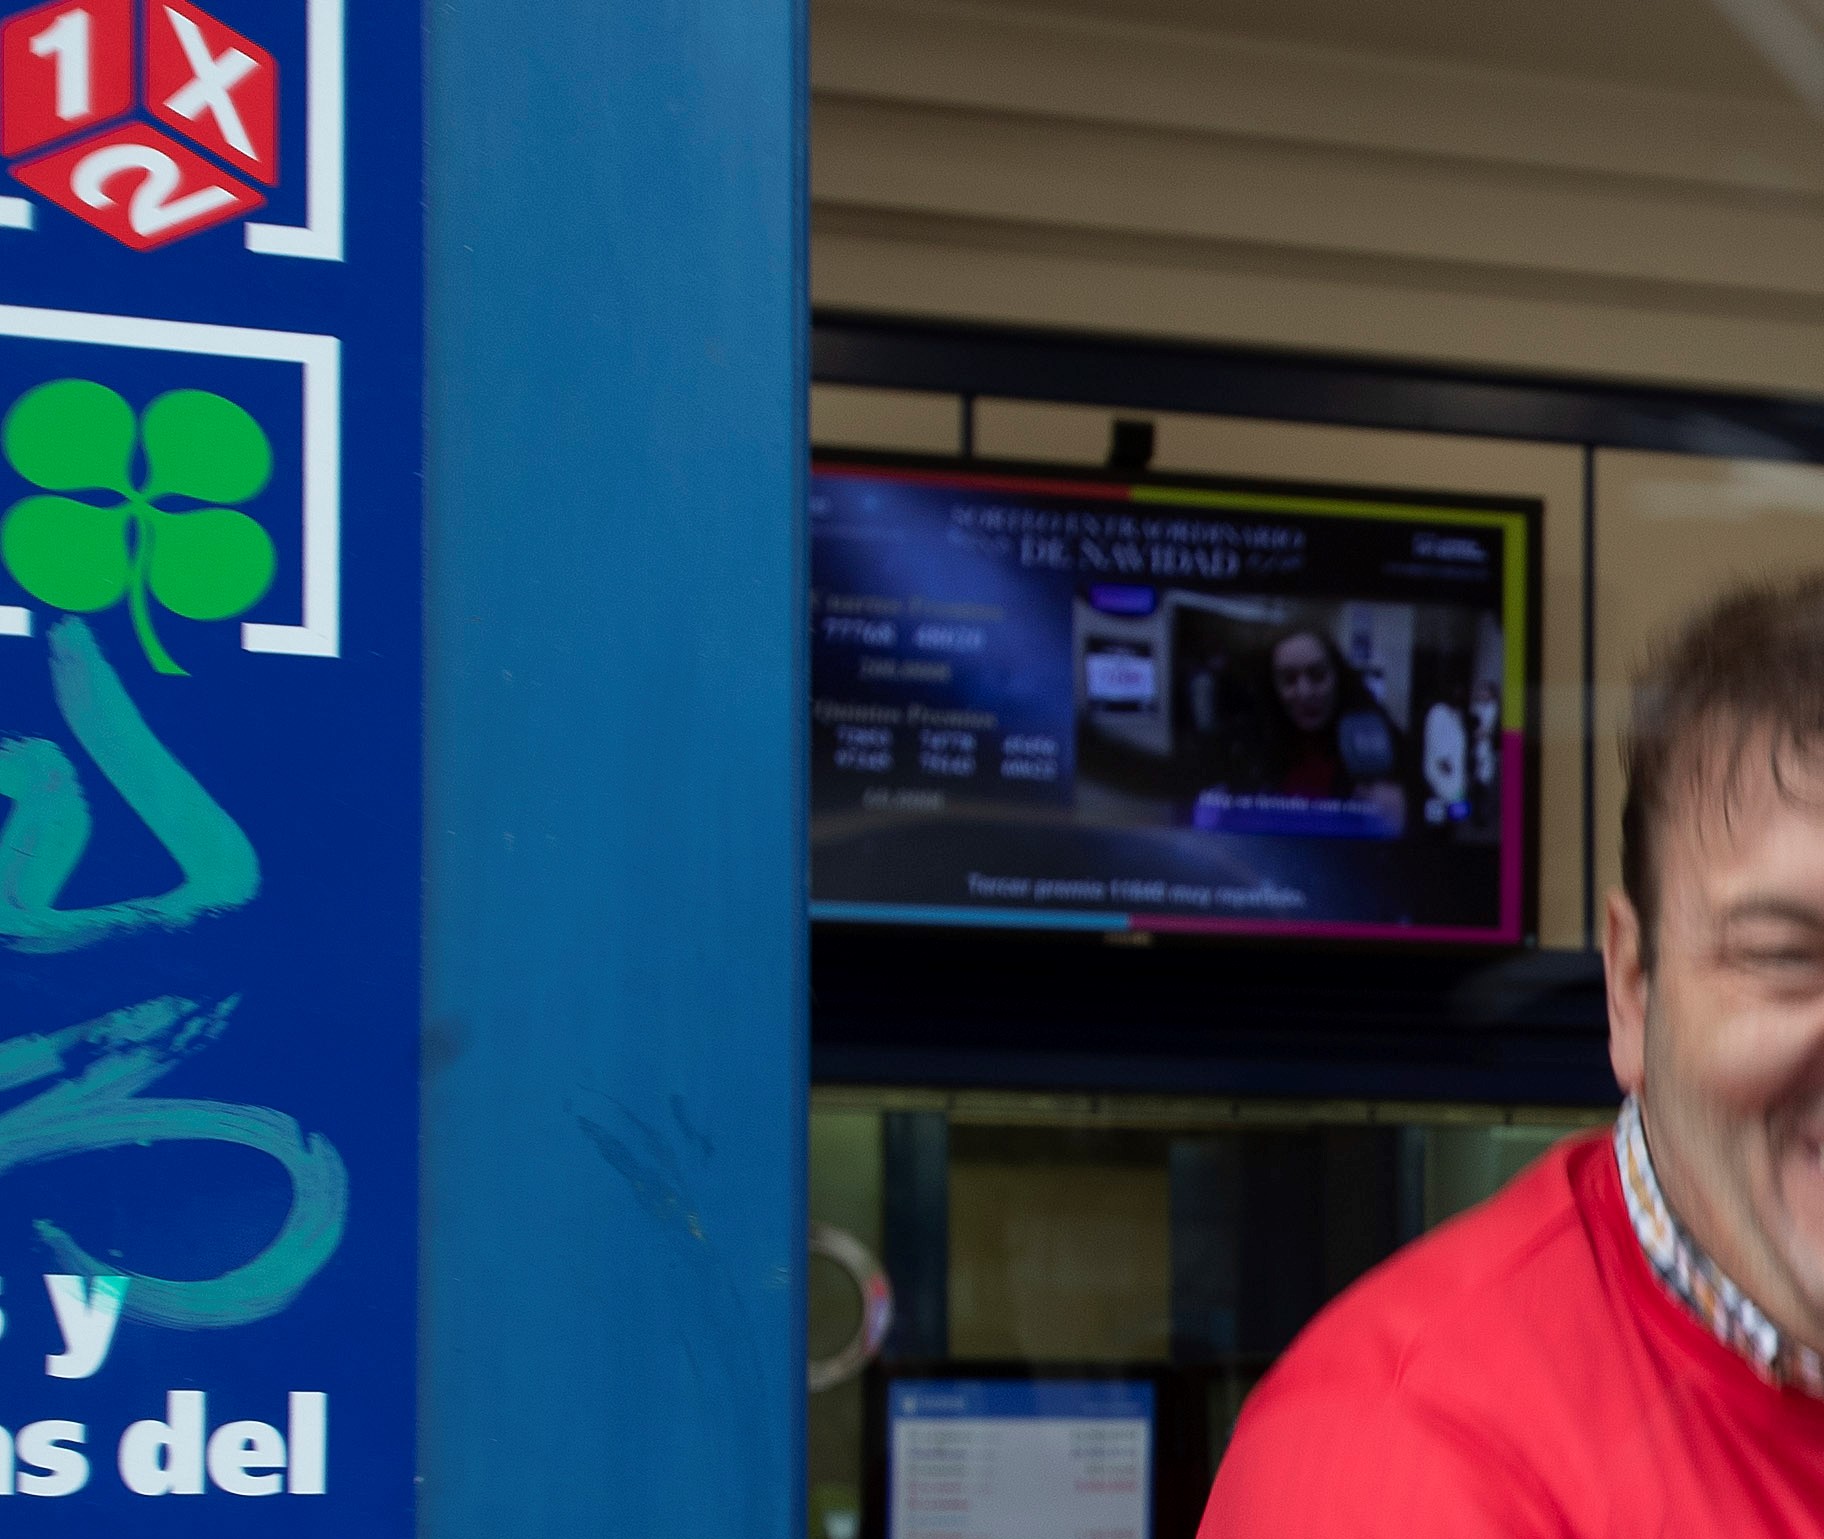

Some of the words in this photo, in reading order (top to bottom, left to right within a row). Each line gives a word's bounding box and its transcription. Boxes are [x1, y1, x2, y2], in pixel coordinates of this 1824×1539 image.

[29, 7, 93, 121] 1
[162, 2, 262, 163] X
[69, 143, 241, 238] 2
[44, 1275, 130, 1378] y
[0, 1418, 91, 1497] s
[118, 1390, 328, 1497] del
